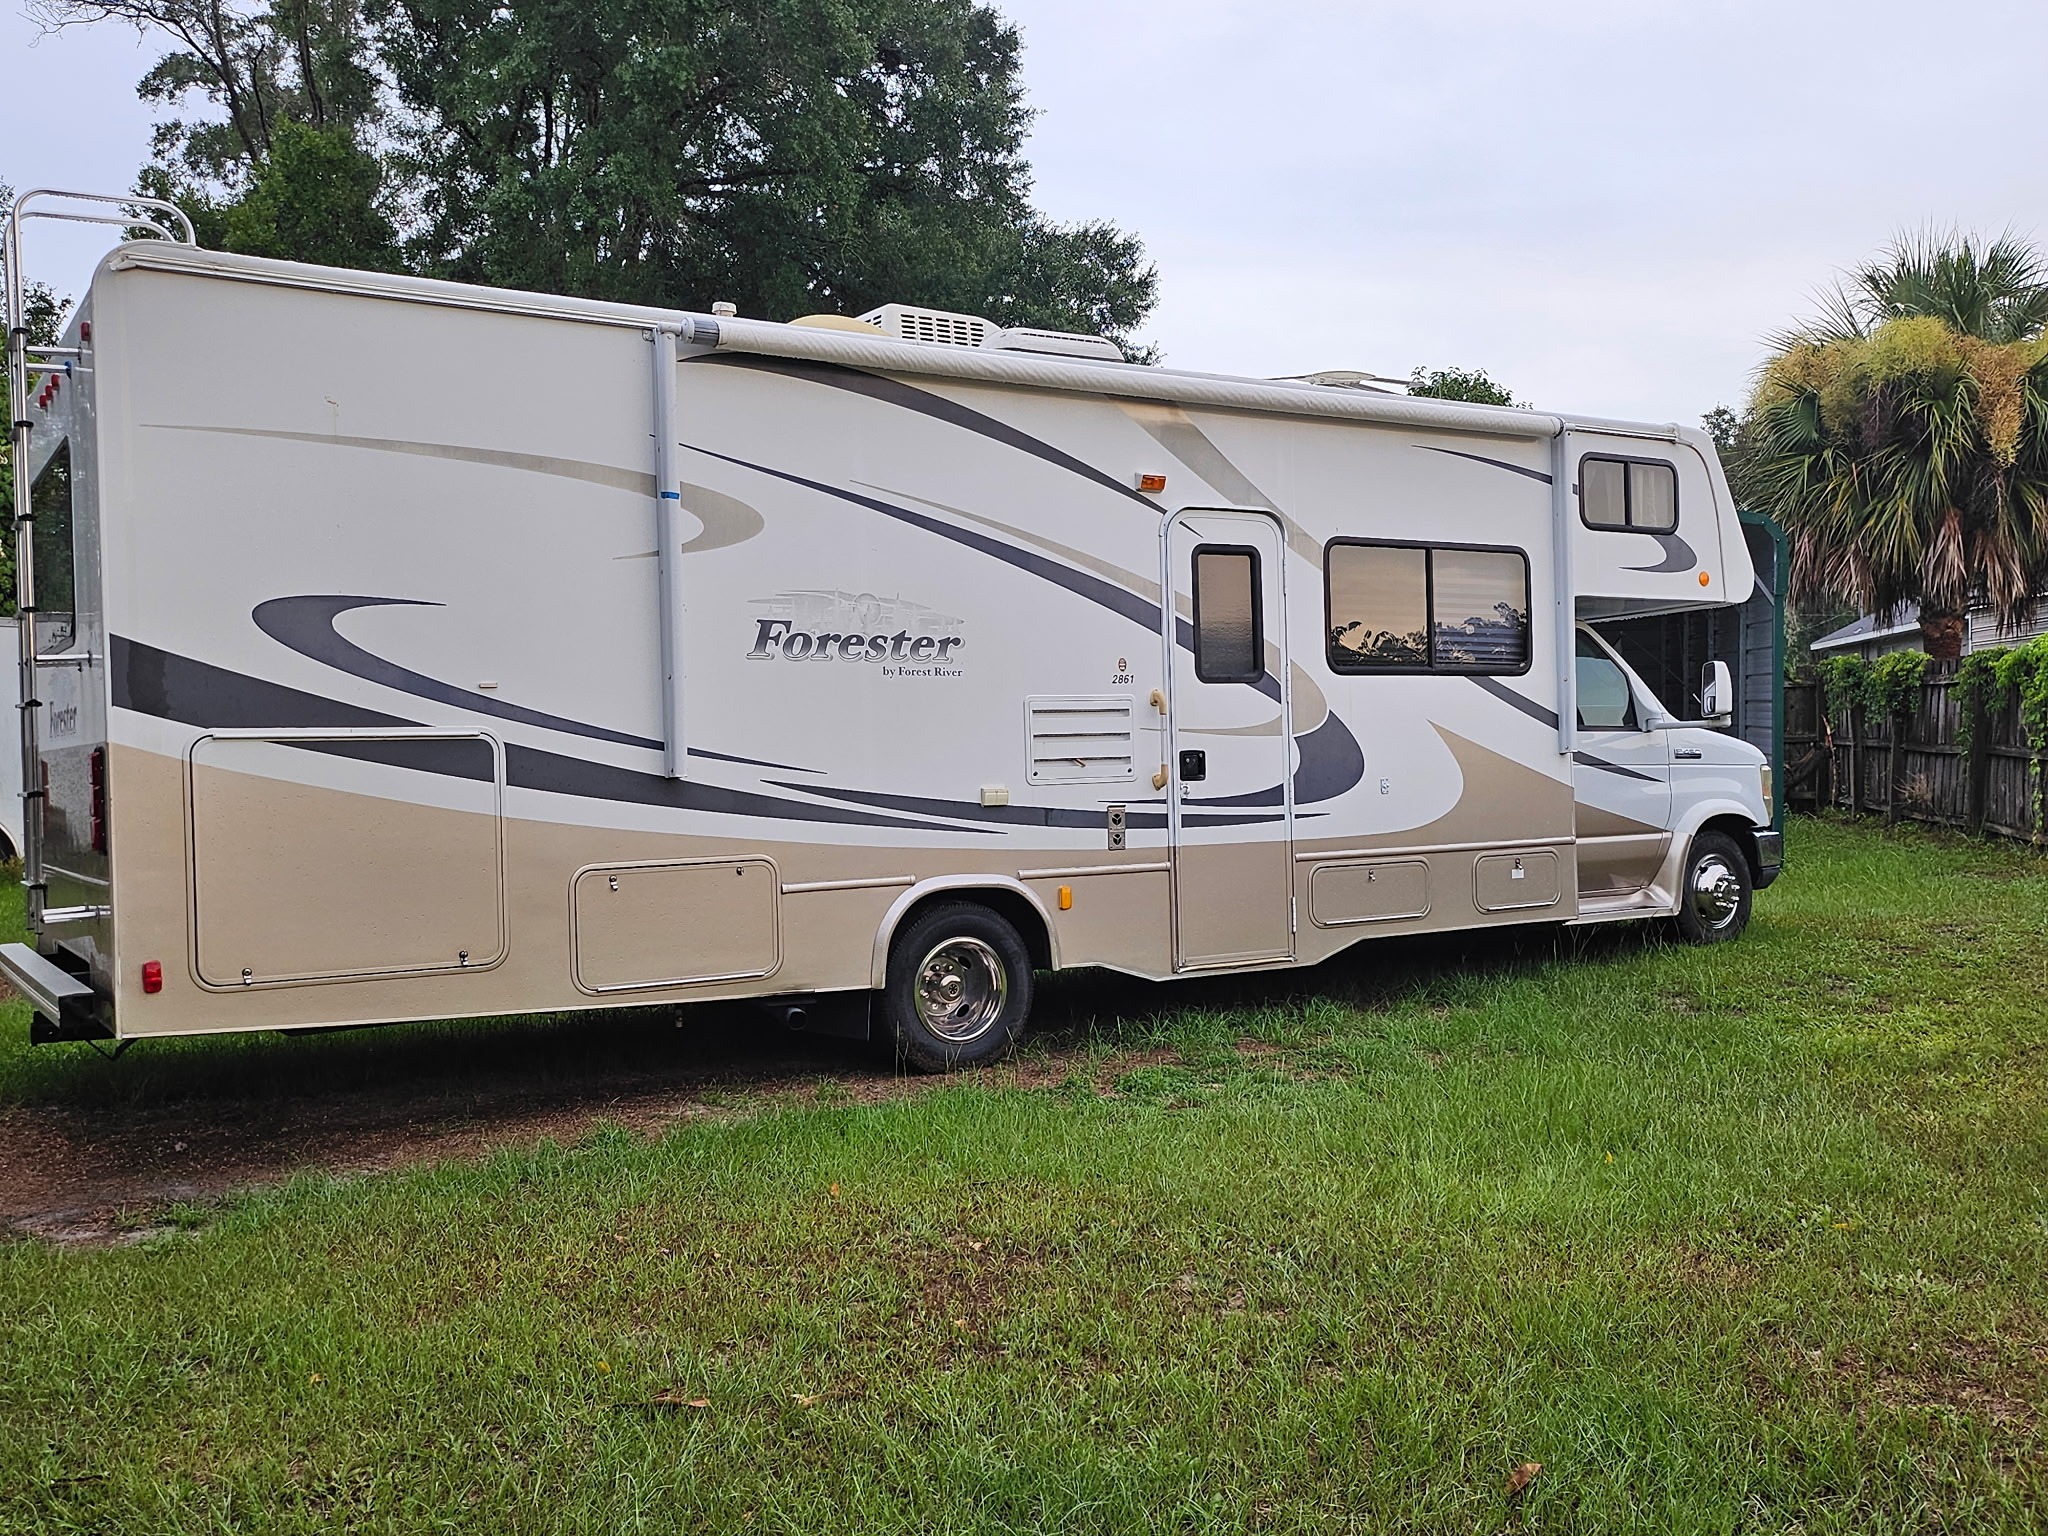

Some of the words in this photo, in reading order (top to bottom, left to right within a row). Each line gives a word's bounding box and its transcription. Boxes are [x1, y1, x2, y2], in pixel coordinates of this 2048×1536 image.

[746, 618, 965, 664] Forester
[882, 666, 896, 679] by
[898, 666, 932, 677] Forest
[934, 667, 963, 677] River
[1111, 674, 1135, 684] 2861
